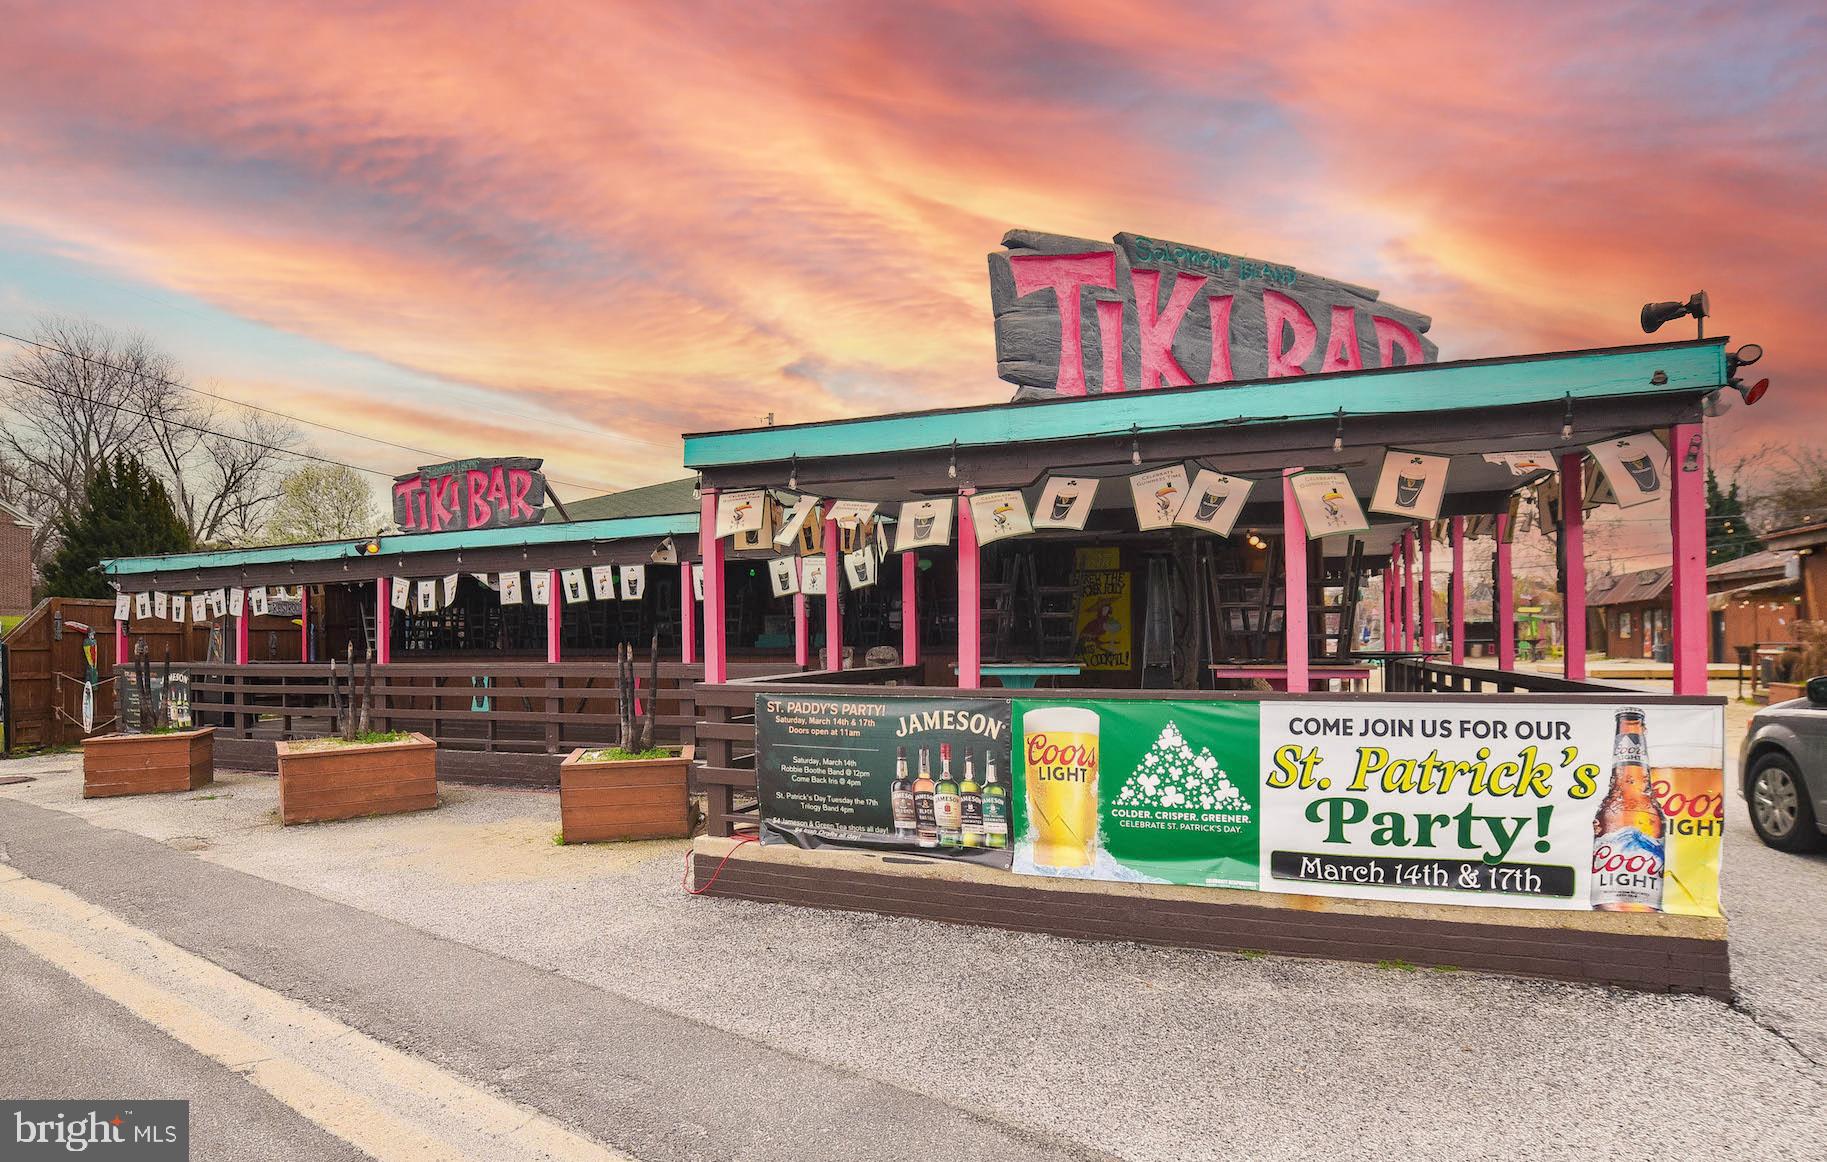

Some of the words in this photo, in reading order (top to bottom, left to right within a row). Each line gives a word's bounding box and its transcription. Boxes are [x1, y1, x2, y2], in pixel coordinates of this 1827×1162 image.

[465, 464, 535, 529] BAR
[767, 701, 784, 713] ST.
[787, 701, 838, 715] PADDY'S
[842, 703, 886, 717] PARTY!
[775, 715, 807, 726] Saturday,
[809, 717, 831, 725] March
[833, 718, 849, 726] 14th
[859, 718, 875, 727] 17th
[895, 710, 1003, 740] JAMESON
[1289, 717, 1354, 737] COME
[1359, 718, 1414, 739] JOIN
[1421, 719, 1453, 739] US
[1460, 720, 1507, 740] FOR
[1514, 721, 1571, 741] OUR
[789, 726, 809, 735] Doors
[811, 728, 829, 736] open
[840, 729, 861, 737] 11am
[1027, 735, 1096, 768] Coors
[793, 756, 821, 766] Saturday,
[822, 758, 842, 766] March
[843, 759, 857, 767] 14th
[781, 765, 803, 773] Robbie
[827, 768, 844, 776] Band
[853, 770, 871, 779] 12pm
[1038, 766, 1087, 783] LIGHT
[1265, 744, 1332, 790] St.
[1347, 745, 1600, 799] Patrick's
[791, 775, 810, 783] Come
[811, 776, 827, 784] Back
[846, 778, 861, 787] 4pm
[786, 792, 813, 801] Patrick's
[813, 794, 827, 803] Day
[828, 795, 853, 806] Tuesday
[854, 798, 865, 806] the
[866, 798, 879, 806] 17th
[800, 802, 821, 812] Trilogy
[822, 803, 839, 812] Band
[840, 806, 855, 815] 4pm
[1111, 808, 1153, 819] COLDER.
[1155, 811, 1199, 822] CRISPER.
[1201, 813, 1252, 824] GREENER.
[782, 818, 808, 828] Jameson
[815, 821, 835, 830] Green
[835, 823, 847, 831] Tea
[848, 823, 866, 833] shots
[874, 826, 889, 835] day!
[1119, 820, 1166, 830] CELEBRATE
[1167, 822, 1178, 831] ST.
[1179, 823, 1222, 832] PATRICK'S
[1223, 825, 1243, 833] DAY.
[1304, 797, 1555, 865] Party!
[1300, 856, 1385, 884] March
[1395, 863, 1449, 887] 14th
[1458, 864, 1480, 890] &
[1490, 866, 1542, 893] 17th
[1599, 872, 1658, 890] LIGHT
